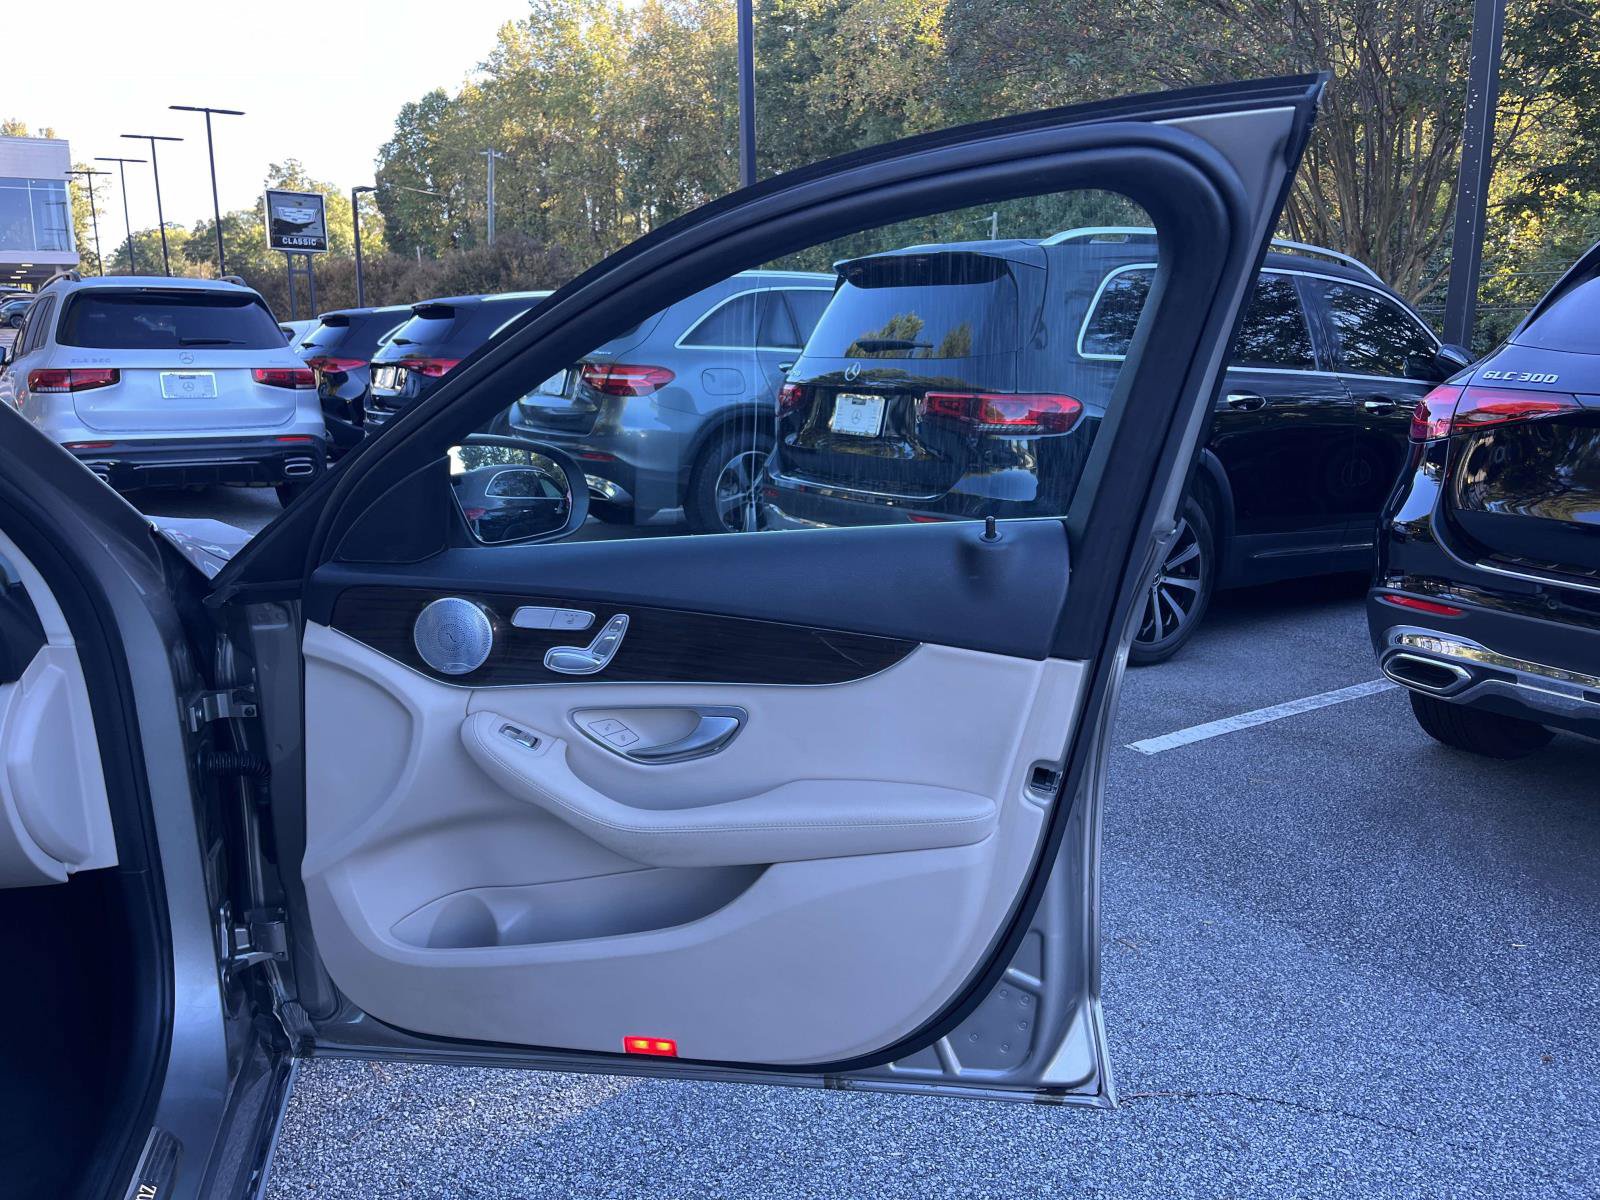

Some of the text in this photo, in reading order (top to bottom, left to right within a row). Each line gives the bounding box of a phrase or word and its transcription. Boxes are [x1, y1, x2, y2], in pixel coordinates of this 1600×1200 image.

[282, 237, 317, 246] CLASSIC
[1482, 370, 1560, 384] GLC 300
